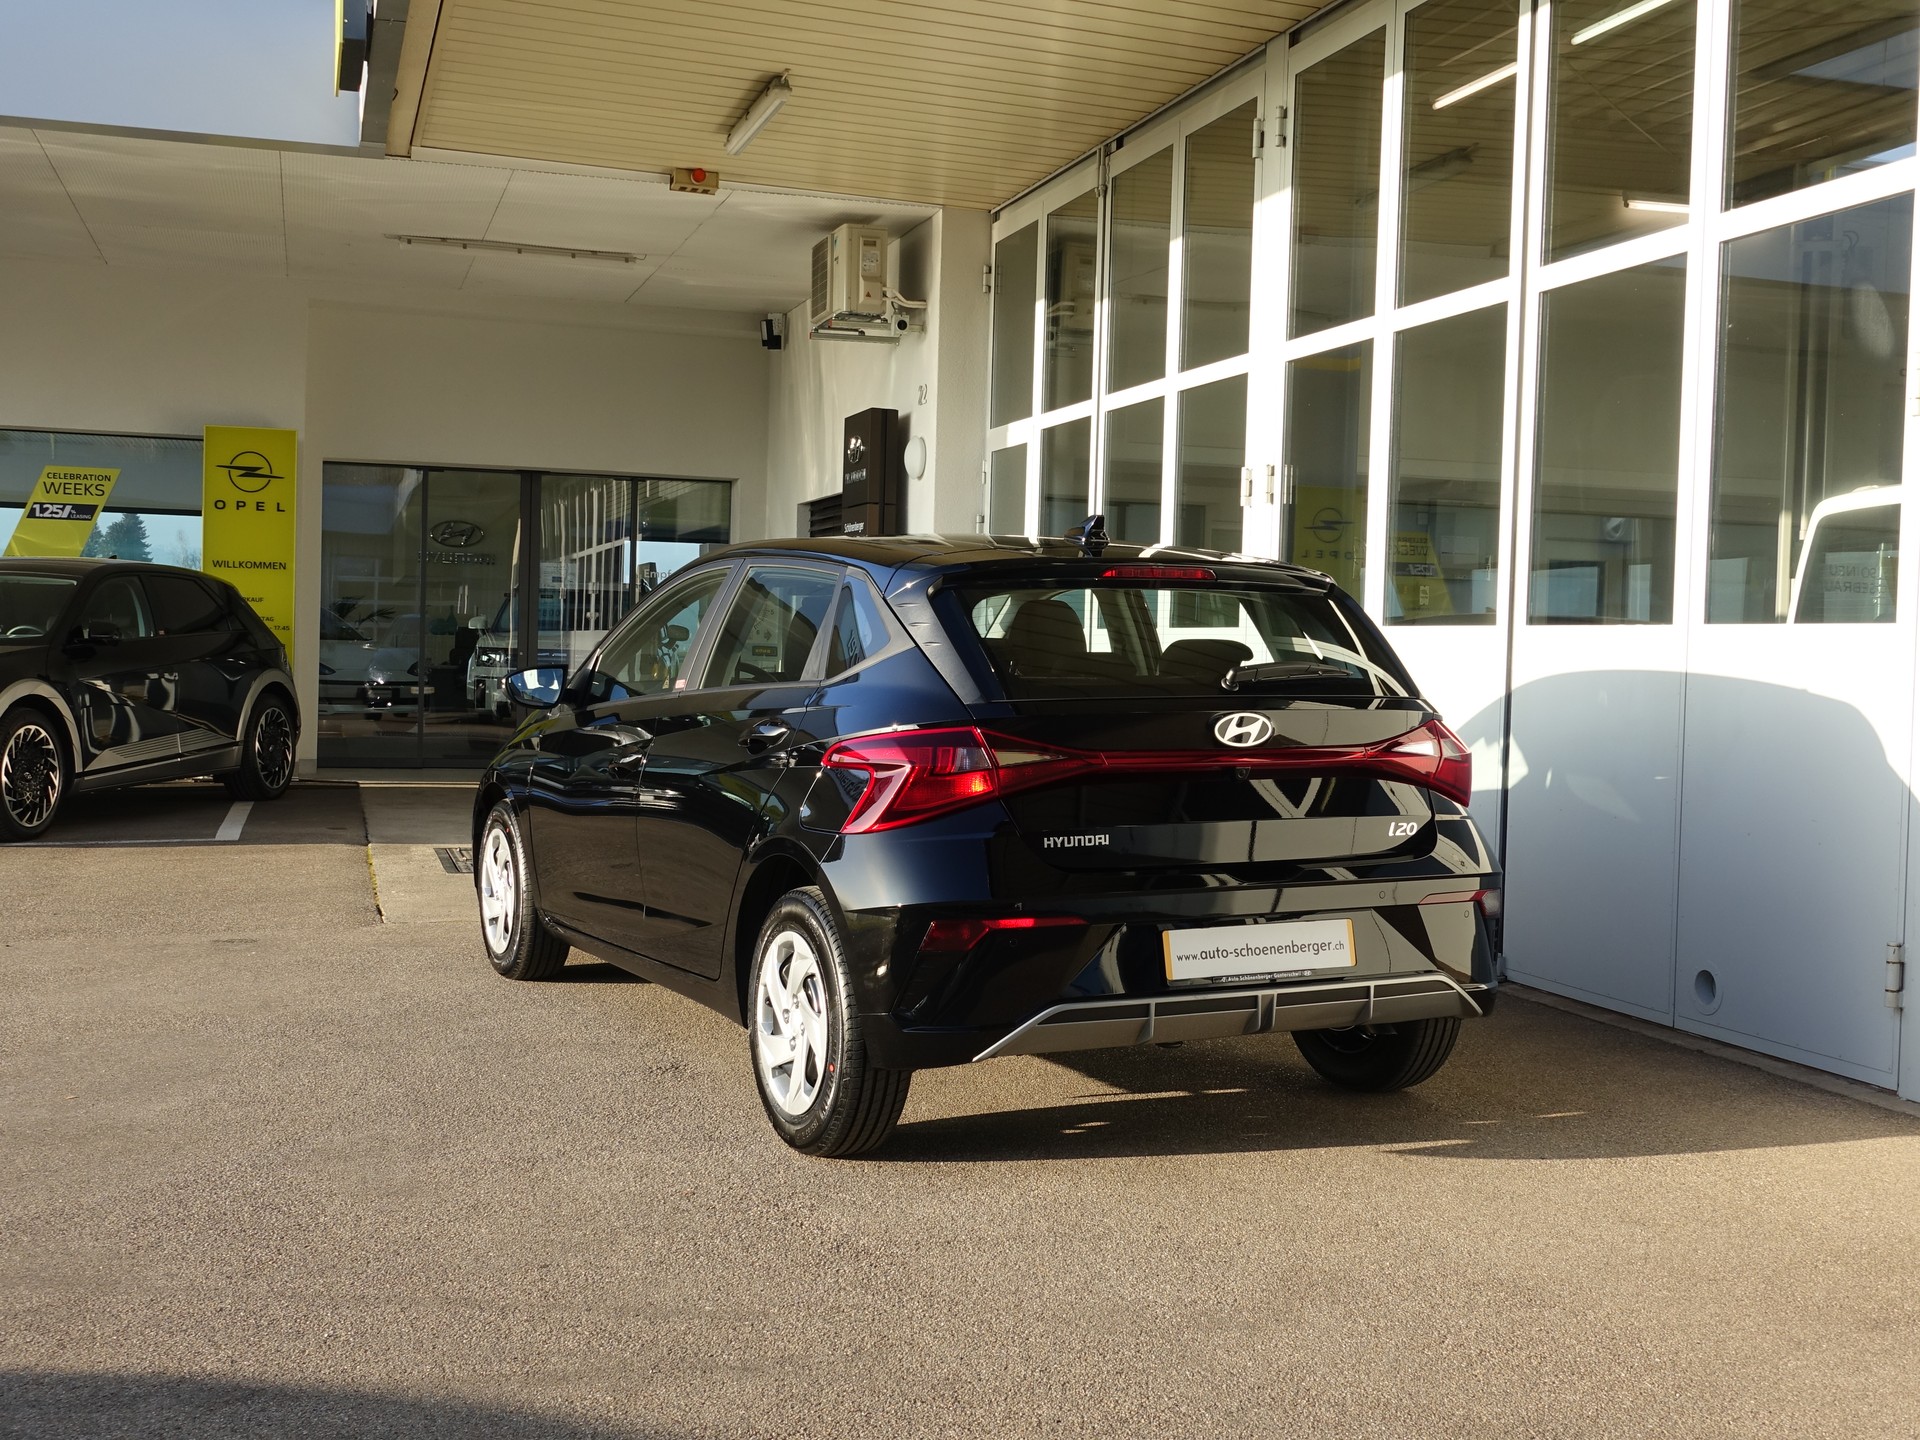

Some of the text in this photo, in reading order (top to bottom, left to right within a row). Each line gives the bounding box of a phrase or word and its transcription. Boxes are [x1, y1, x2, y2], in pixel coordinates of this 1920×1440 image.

[46, 472, 111, 482] CELEBRATION
[43, 481, 105, 496] WEEKS
[214, 499, 286, 512] OPEL
[212, 560, 287, 570] WILLKOMMEN
[1043, 834, 1110, 849] HYUNDAI
[1176, 940, 1345, 962] www.auto-schoenenberger.ch
